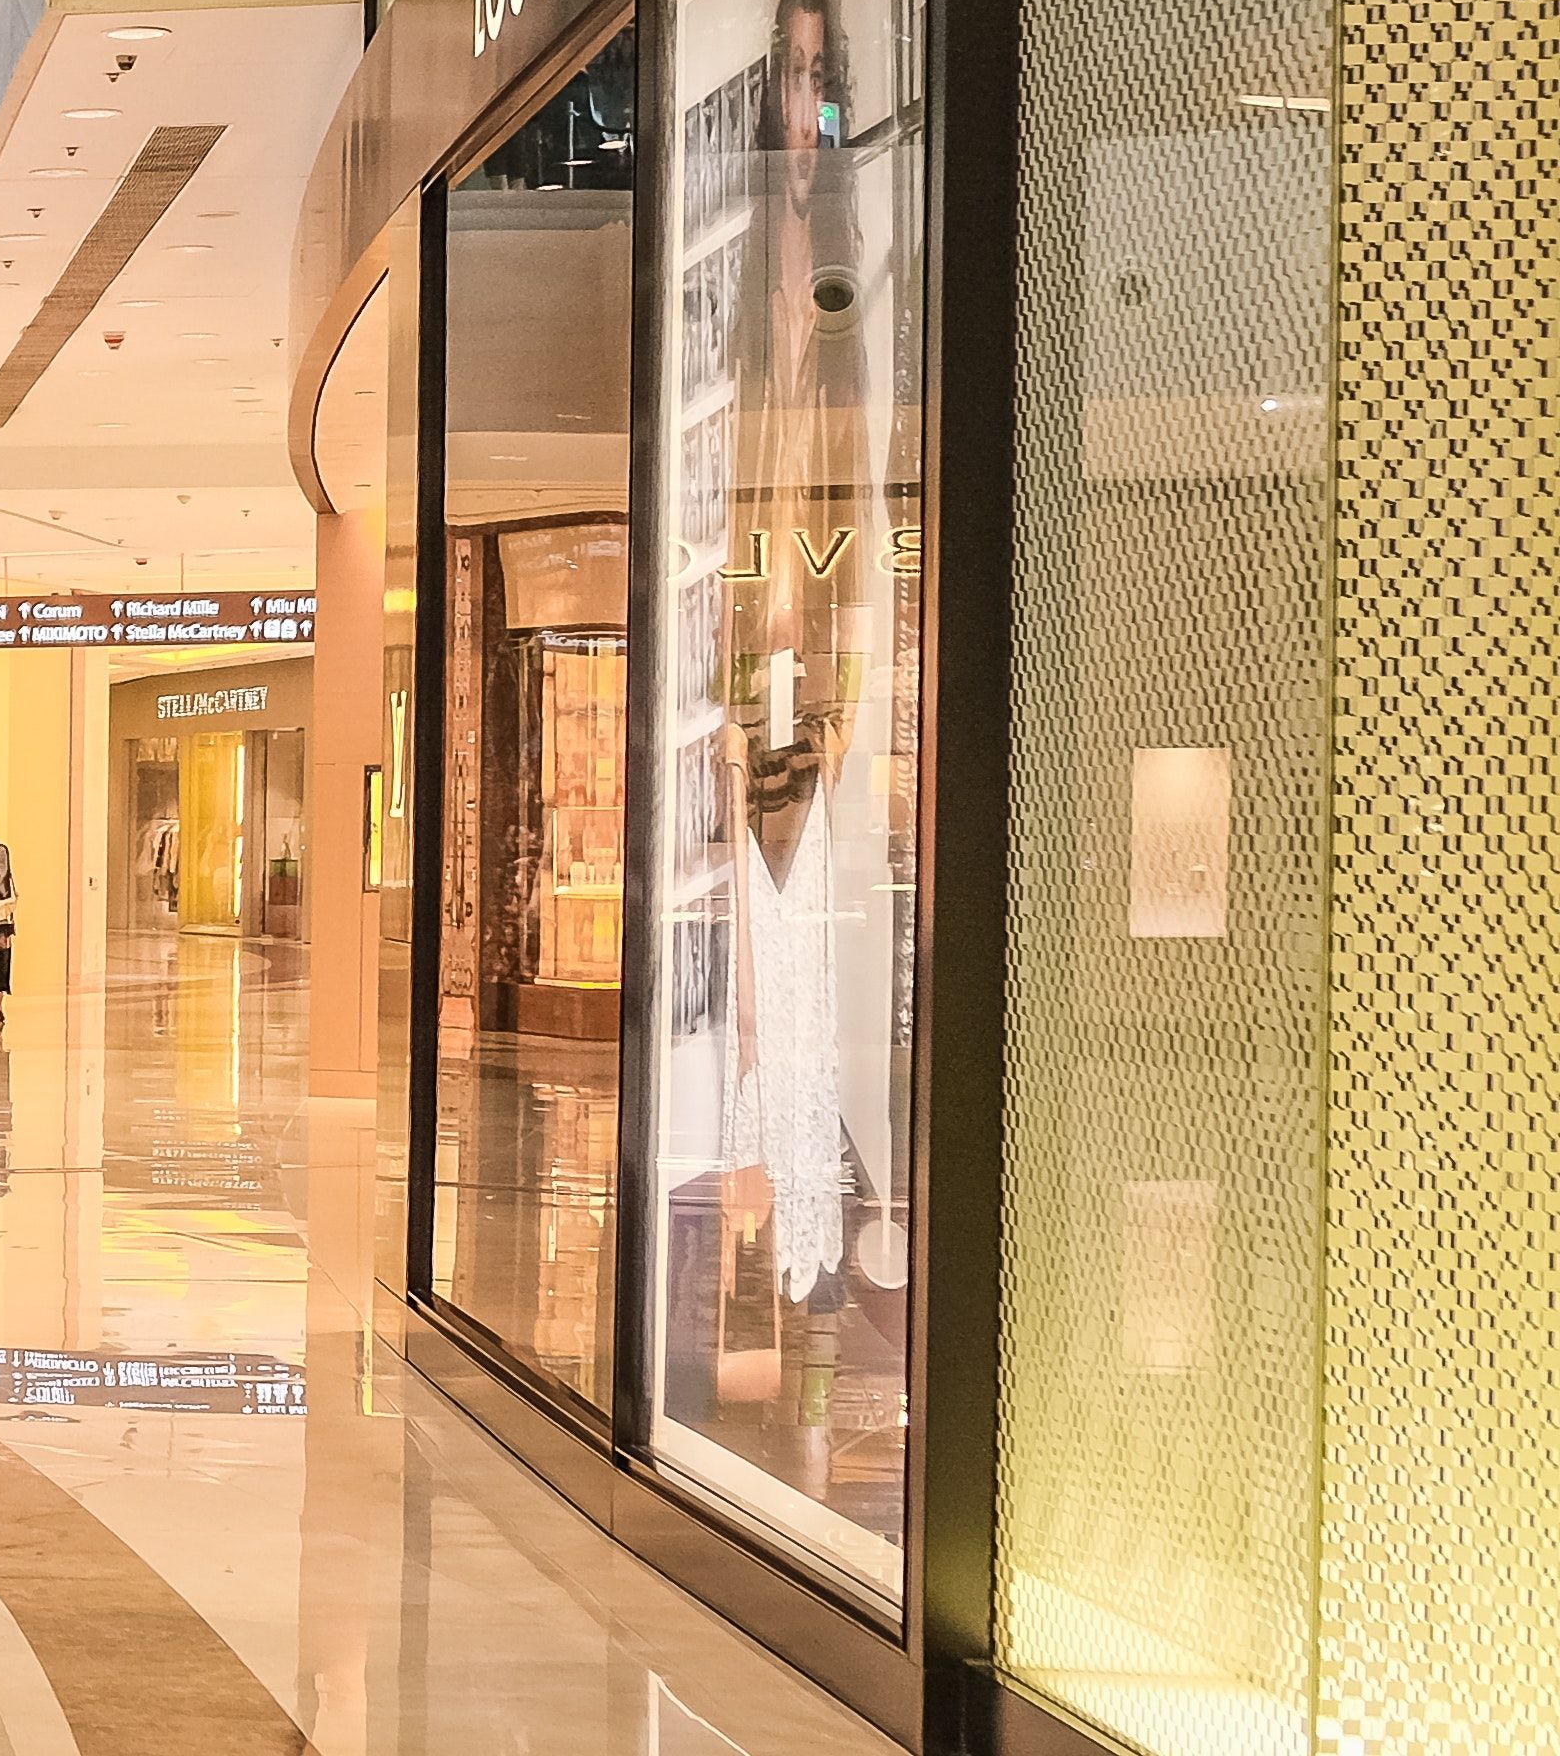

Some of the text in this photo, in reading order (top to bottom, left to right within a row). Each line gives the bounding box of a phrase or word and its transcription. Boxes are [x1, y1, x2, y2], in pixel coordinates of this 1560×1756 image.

[32, 603, 83, 620] Corum
[125, 599, 220, 617] Richard Mille
[265, 597, 317, 614] Miu Mi
[31, 626, 108, 643] MIKIMOTO
[125, 622, 248, 641] Stella McCartney
